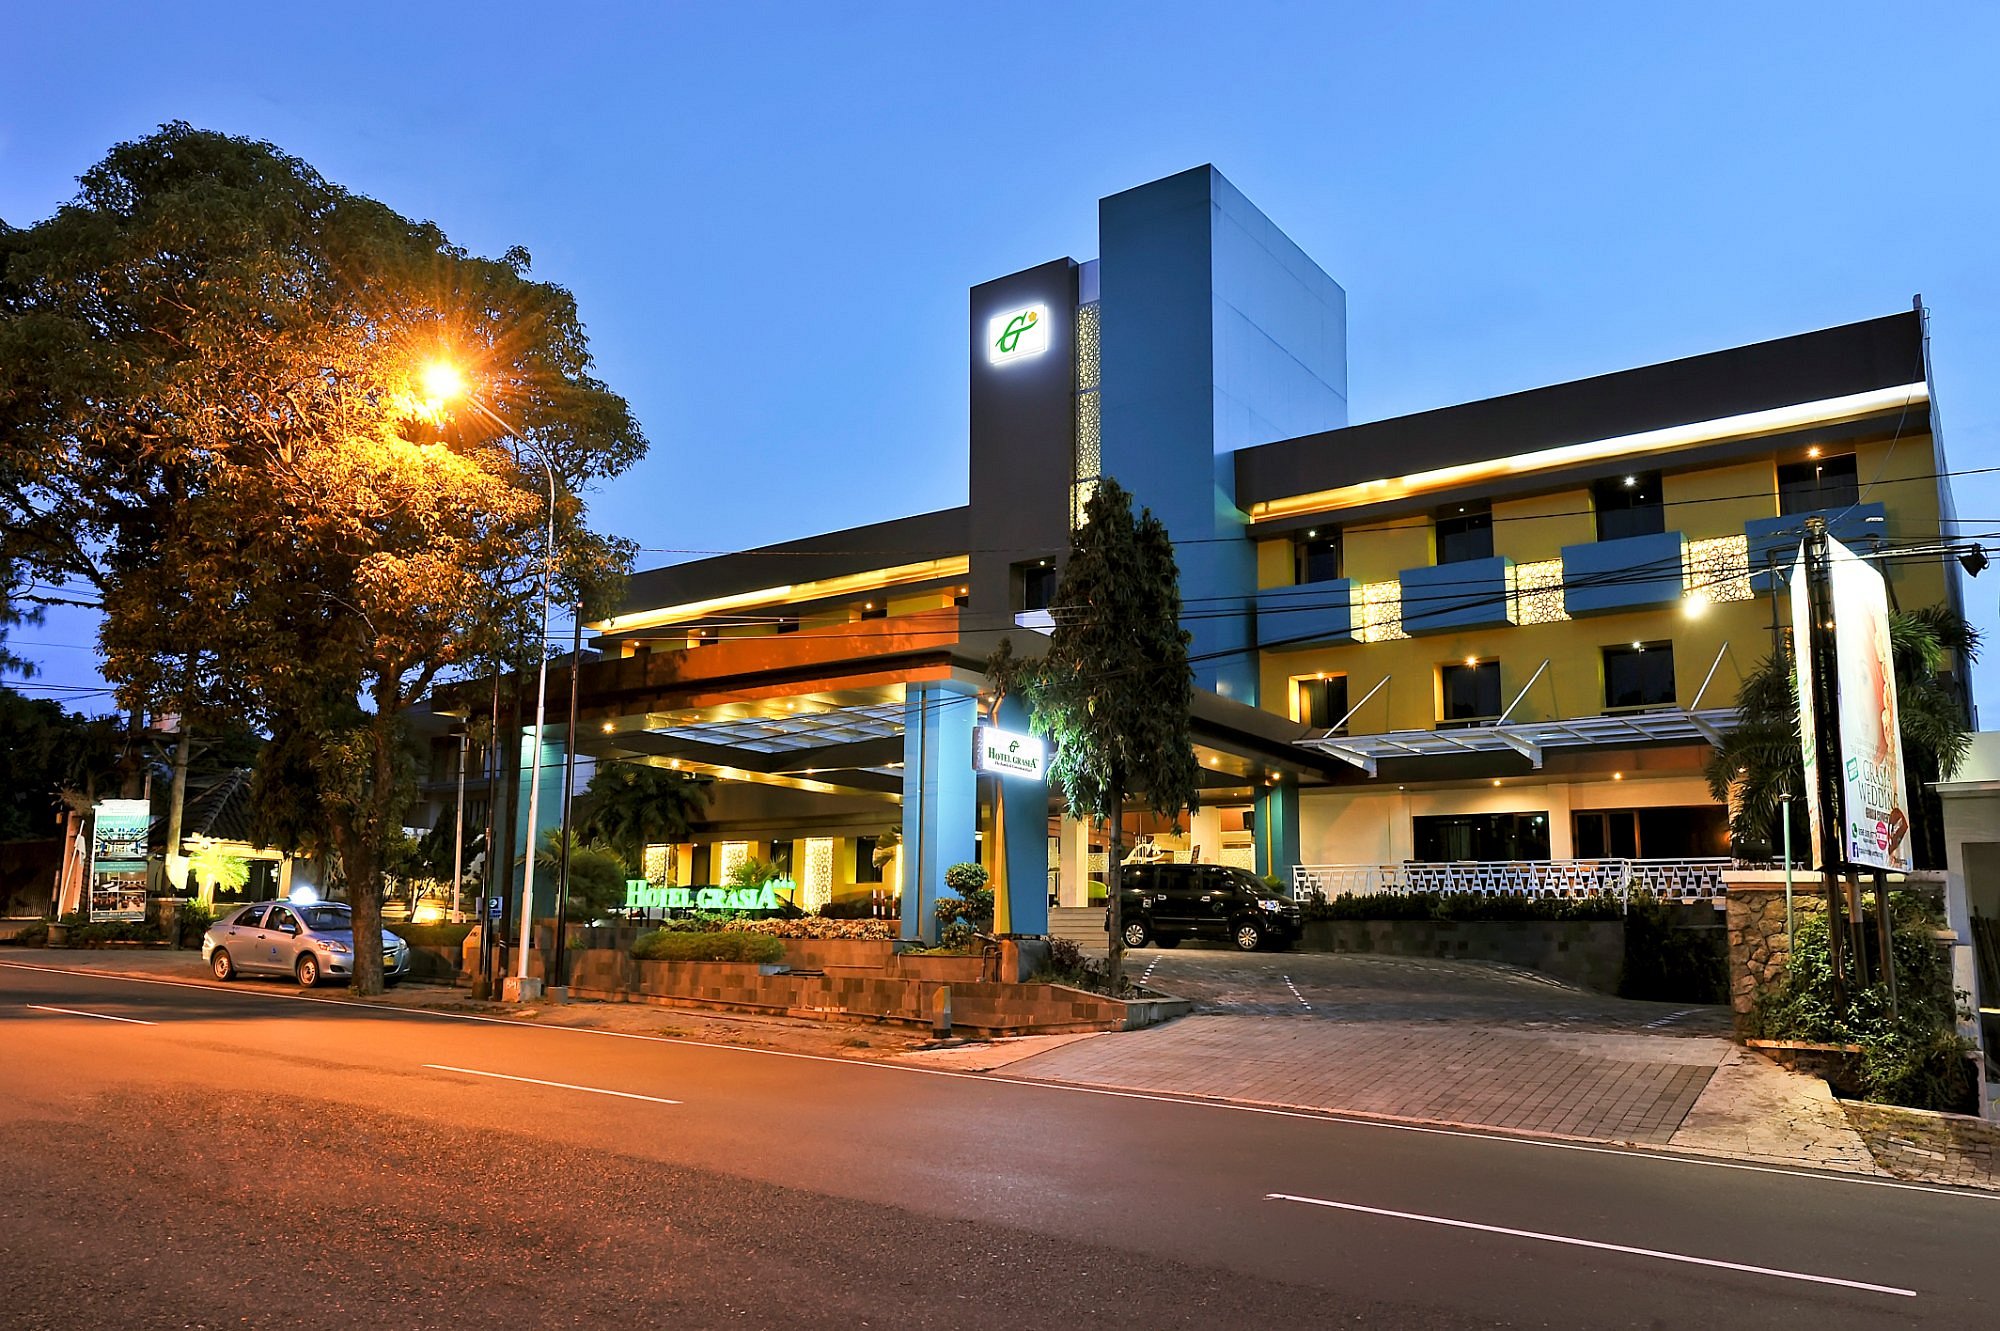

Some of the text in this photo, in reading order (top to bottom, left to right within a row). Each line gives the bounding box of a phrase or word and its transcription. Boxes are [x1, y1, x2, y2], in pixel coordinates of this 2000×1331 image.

[988, 746, 1012, 763] HOTEL
[1012, 756, 1037, 769] GRASIA
[626, 879, 780, 910] HOTEL GRASIA
